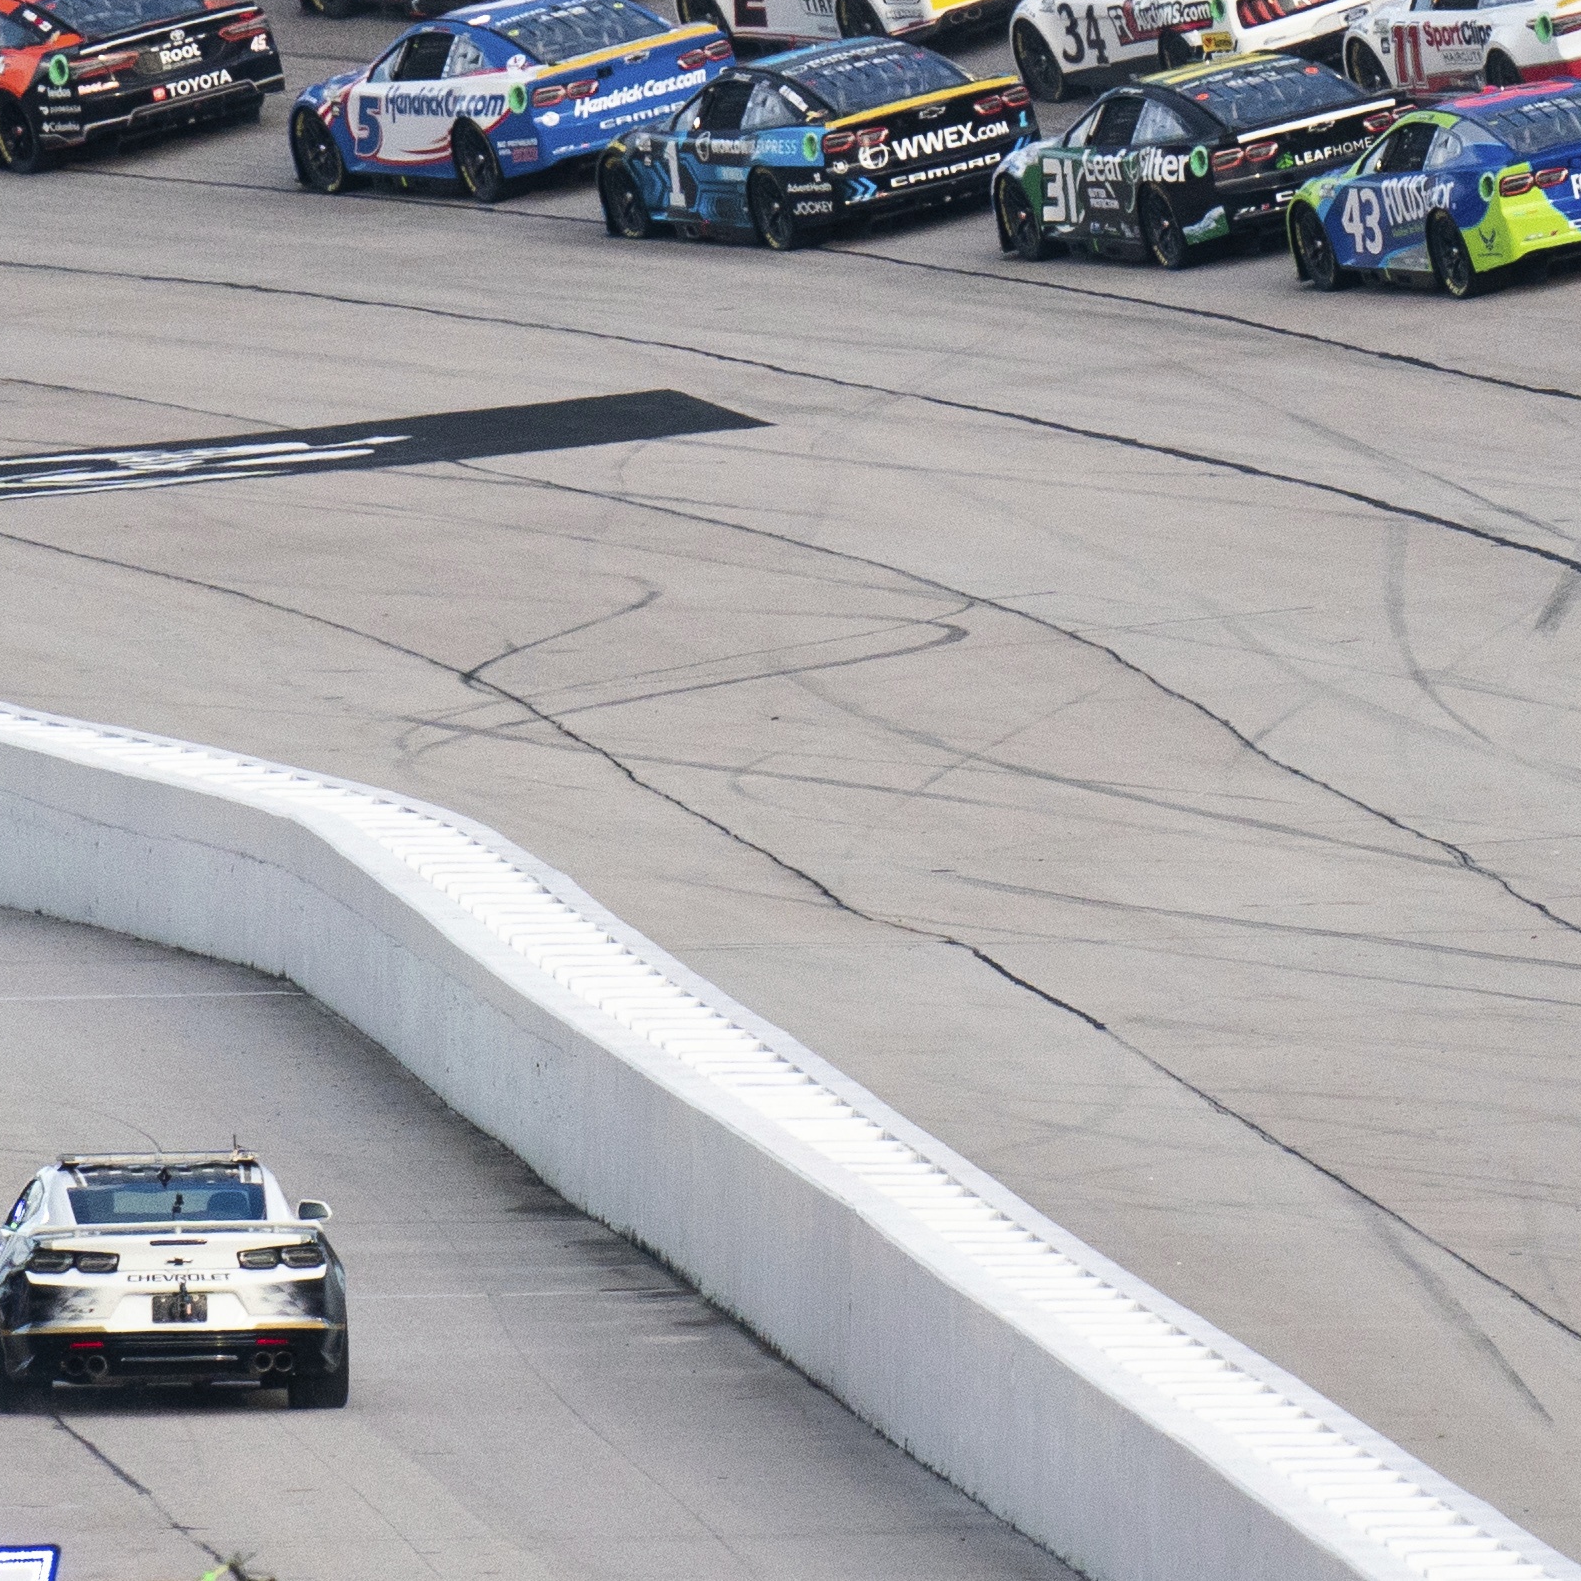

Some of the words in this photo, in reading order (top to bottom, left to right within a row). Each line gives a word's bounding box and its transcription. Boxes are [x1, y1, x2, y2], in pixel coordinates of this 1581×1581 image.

[249, 35, 267, 54] 45
[1057, 3, 1109, 65] 34
[1391, 22, 1429, 88] 11
[164, 67, 233, 99] TOYOTA
[351, 96, 384, 157] 5
[892, 119, 1010, 162] WWEX.COM
[665, 137, 687, 209] 1
[890, 151, 1002, 188] CAMARO
[1042, 158, 1078, 224] 31
[792, 199, 834, 216] JOCKEY
[1341, 188, 1383, 254] 43
[126, 1270, 232, 1284] CHEVROLET
